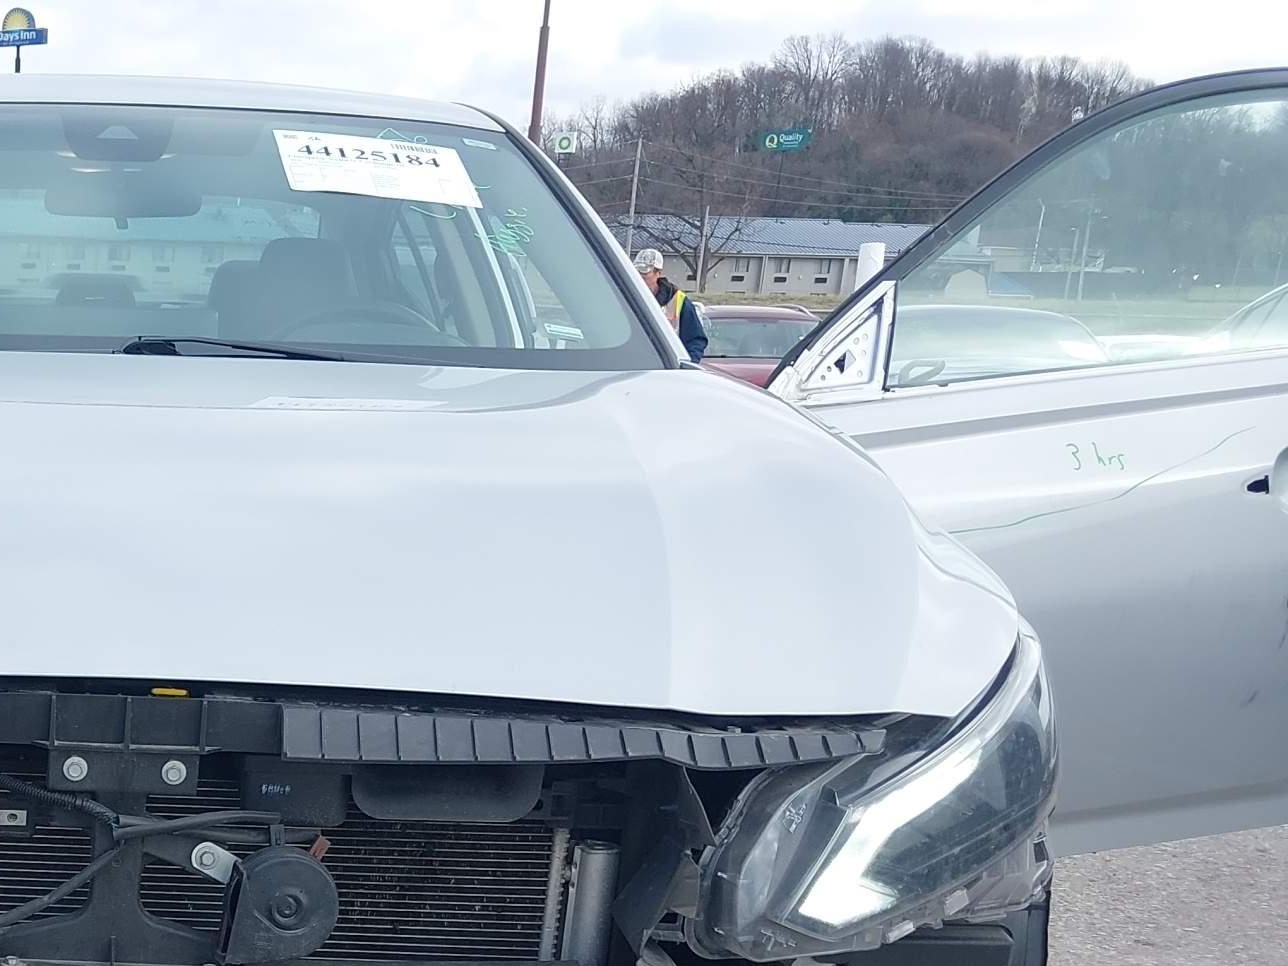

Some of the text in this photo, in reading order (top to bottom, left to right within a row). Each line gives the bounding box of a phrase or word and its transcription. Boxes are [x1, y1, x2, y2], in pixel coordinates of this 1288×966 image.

[20, 30, 37, 40] Inn
[779, 132, 804, 143] Quality
[297, 144, 441, 168] 44125184
[1065, 441, 1125, 471] 3 hrs
